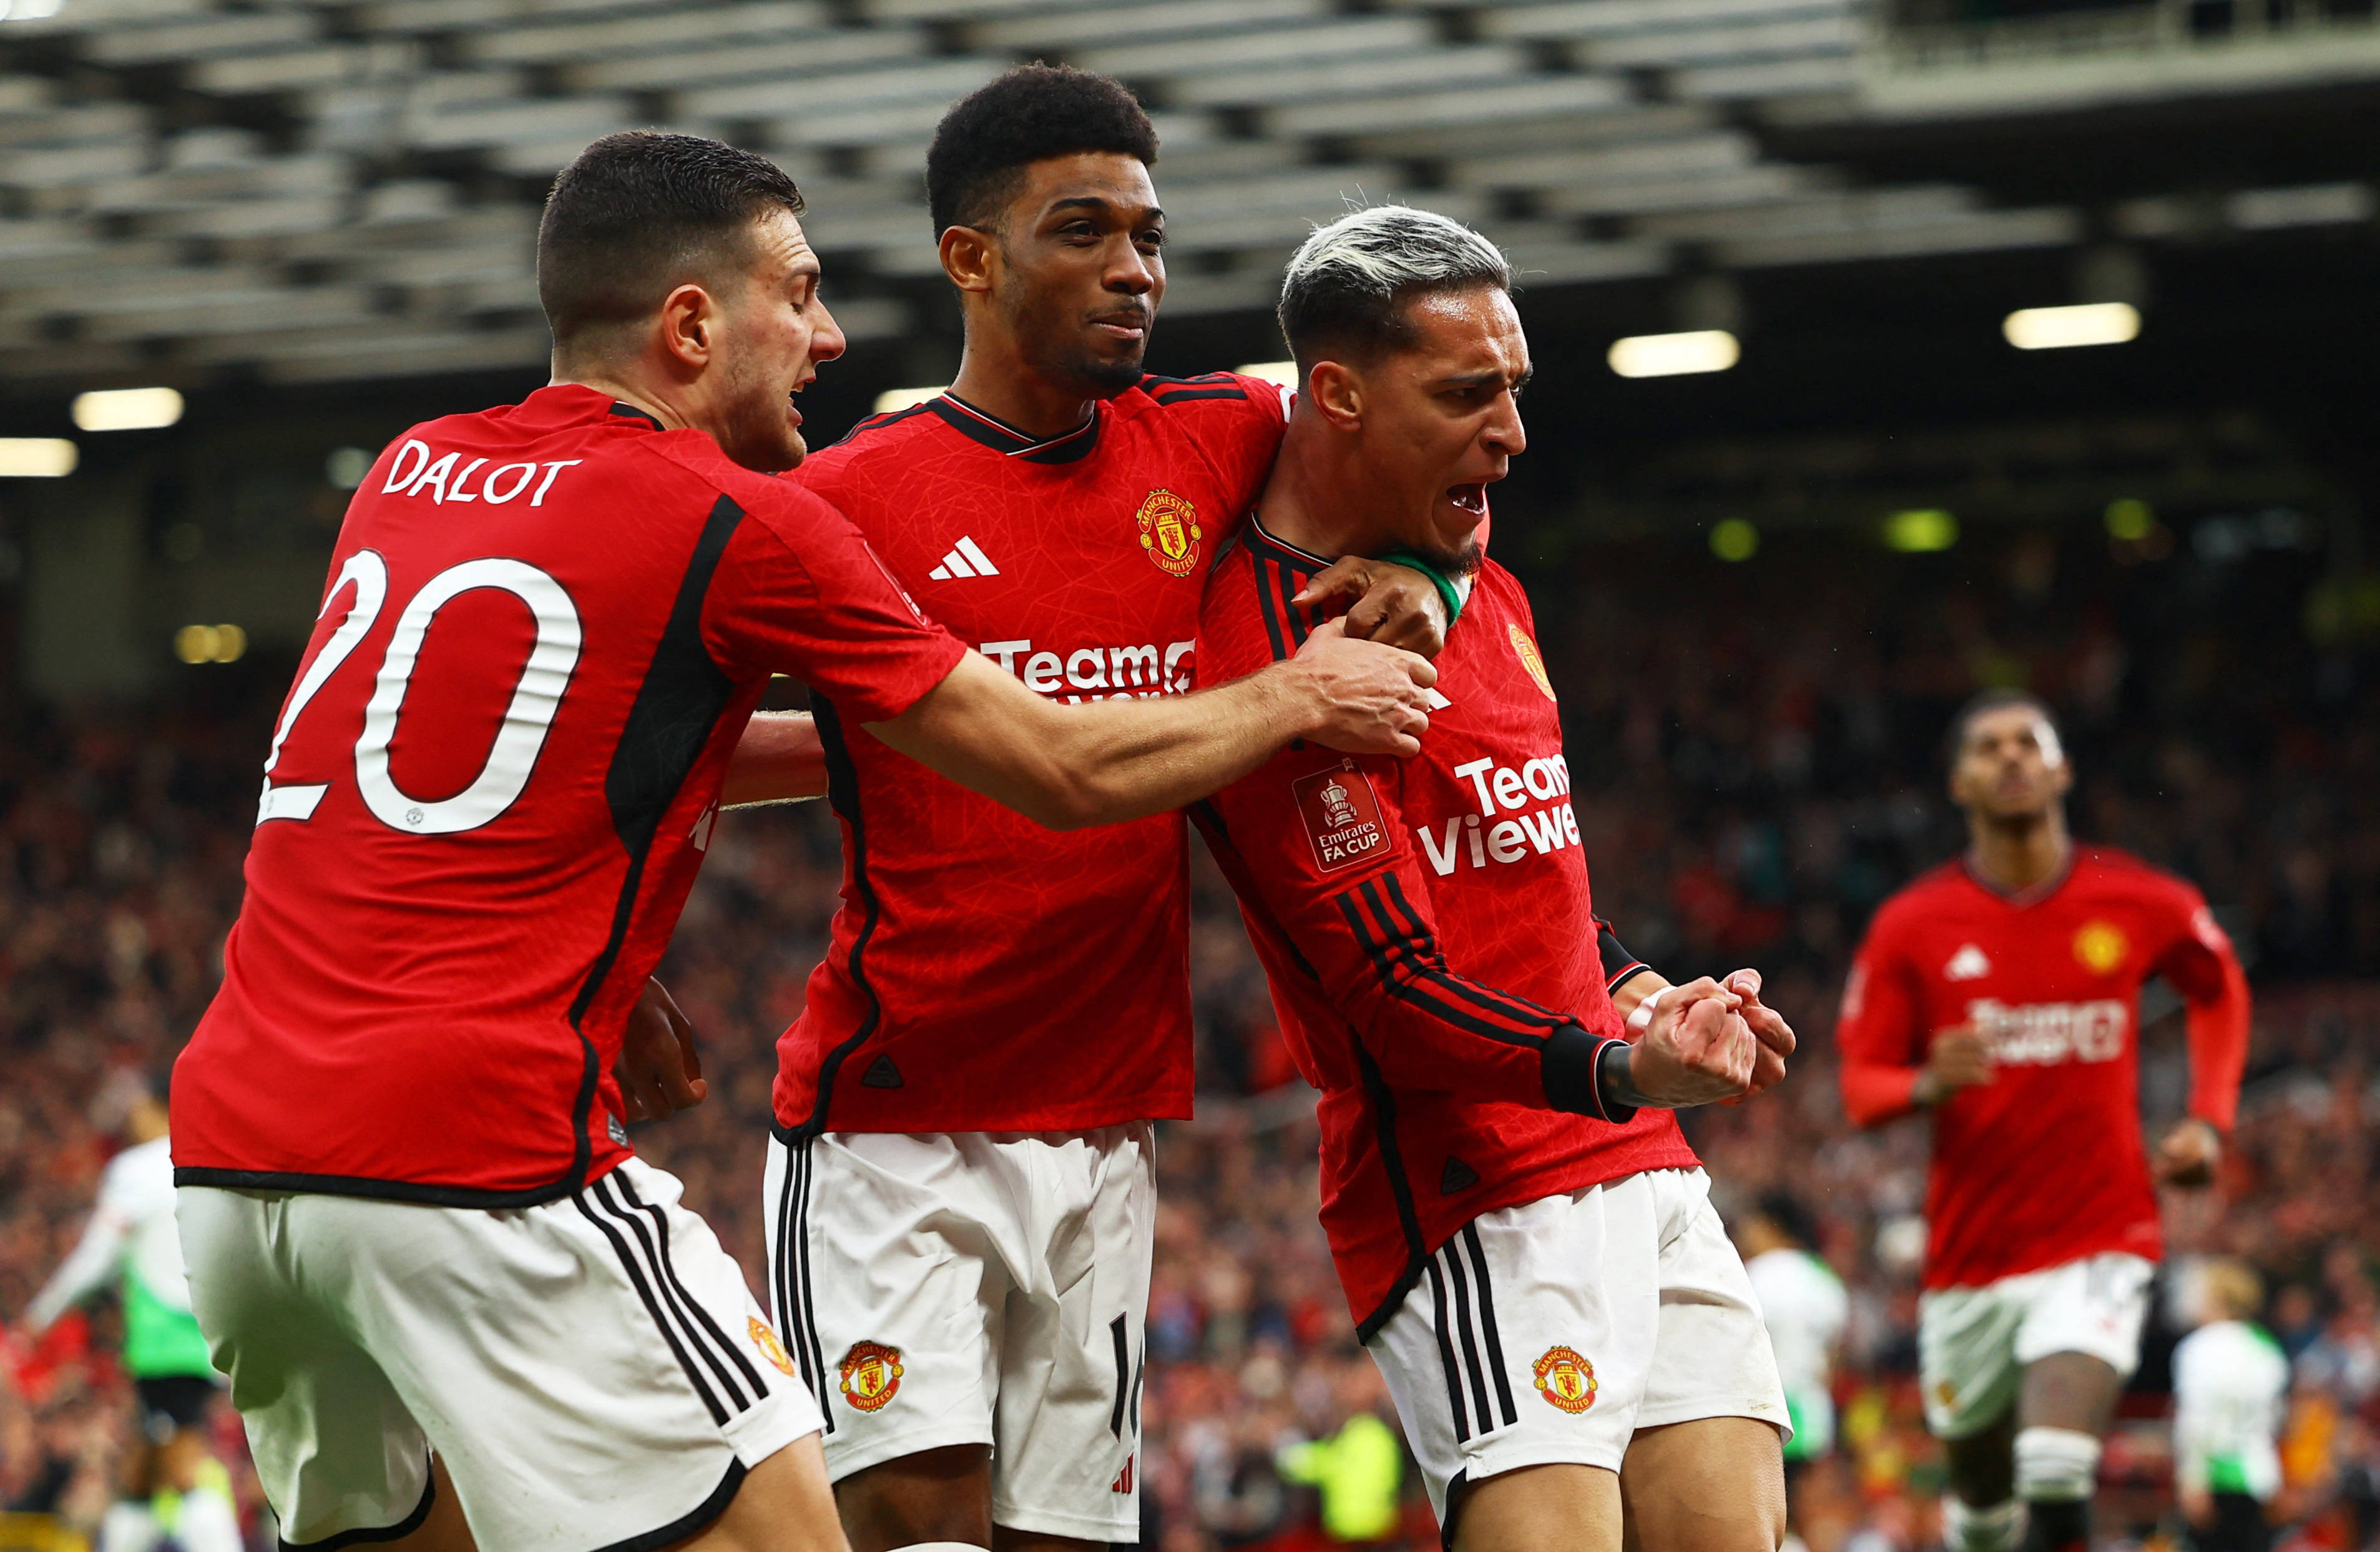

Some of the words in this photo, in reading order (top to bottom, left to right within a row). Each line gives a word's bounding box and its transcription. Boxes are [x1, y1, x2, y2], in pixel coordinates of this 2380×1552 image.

[382, 440, 583, 506] DALOT
[1142, 496, 1191, 527] MANCHESTER
[1162, 554, 1194, 571] UNITED
[980, 639, 1159, 692] Team
[256, 547, 584, 835] 20
[1318, 821, 1376, 848] Emirates
[1323, 845, 1346, 862] FA
[1346, 832, 1379, 854] CUP
[1417, 802, 1581, 877] Viewe
[1539, 1351, 1590, 1373] MANCHESTER
[856, 1390, 892, 1407] UNITED
[1555, 1397, 1589, 1409] UNITED
